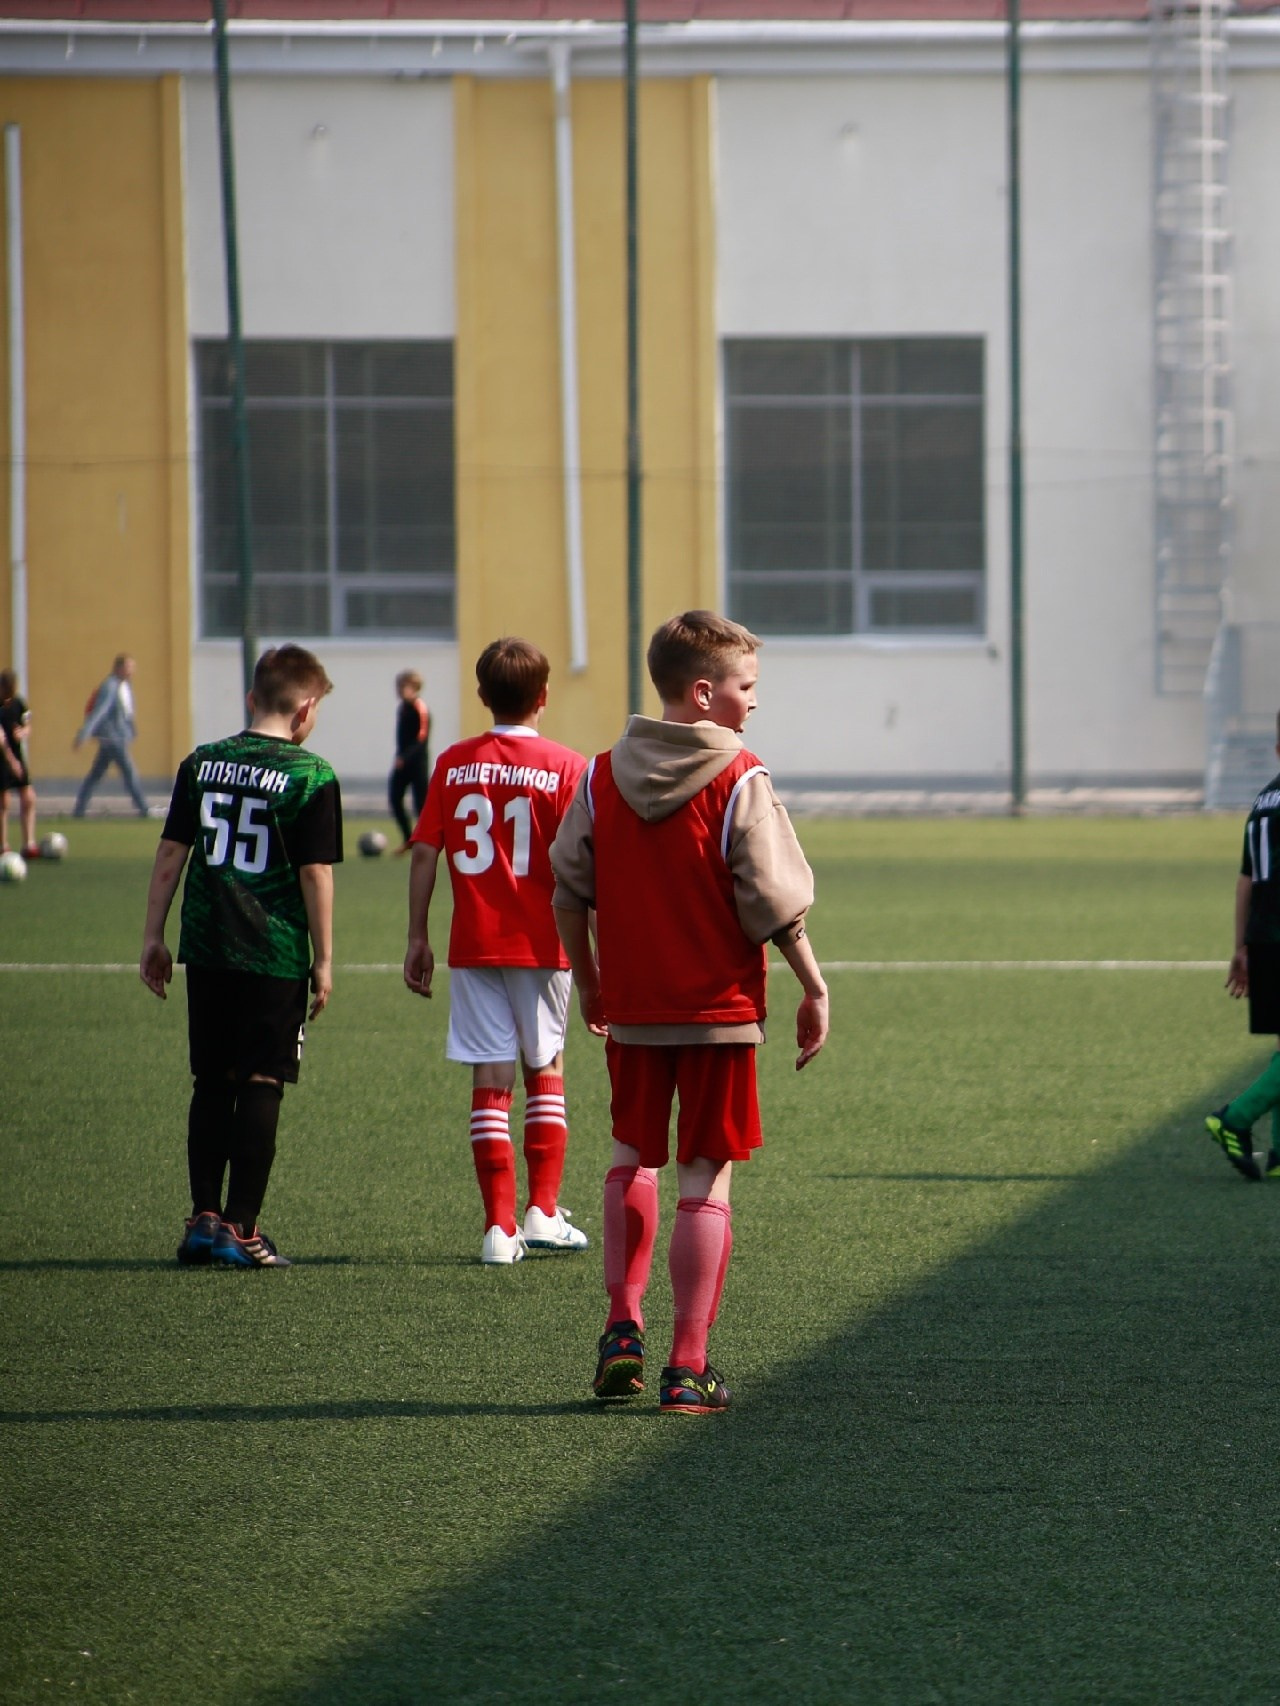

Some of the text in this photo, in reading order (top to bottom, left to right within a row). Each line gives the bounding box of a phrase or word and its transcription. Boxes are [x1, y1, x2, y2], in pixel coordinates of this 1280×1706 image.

[196, 760, 290, 794] ПЛЯСКИН
[446, 762, 560, 793] РЕШЕТНИКОВ
[200, 792, 269, 874] 55
[453, 793, 532, 877] 31
[1247, 816, 1270, 882] 11
